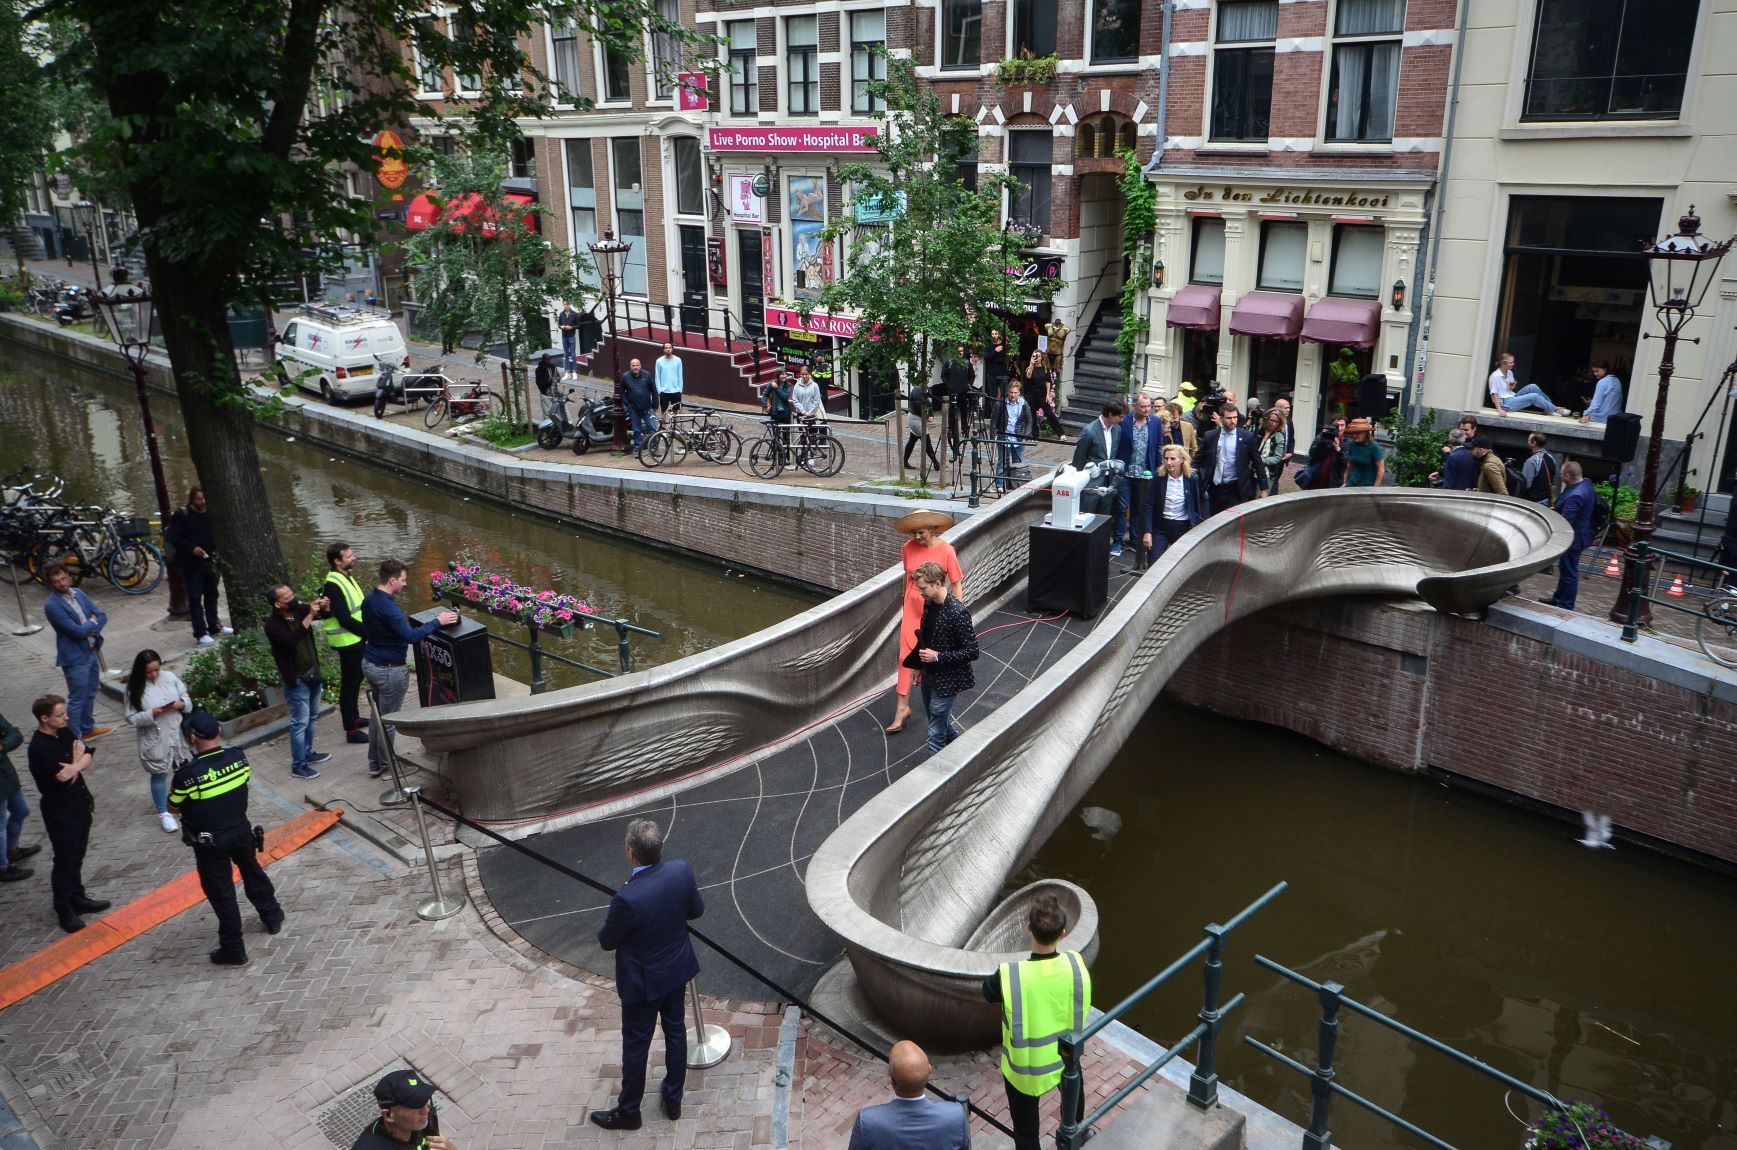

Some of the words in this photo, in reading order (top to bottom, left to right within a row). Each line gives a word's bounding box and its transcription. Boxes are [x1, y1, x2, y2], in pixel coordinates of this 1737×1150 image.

[713, 133, 733, 146] Live
[735, 133, 766, 146] Porno
[768, 133, 797, 147] Show
[803, 133, 849, 149] Hospital
[852, 133, 866, 147] Ba
[1184, 185, 1213, 200] In
[1221, 186, 1252, 201] den
[829, 319, 858, 335] ROSS
[1056, 489, 1070, 497] ABB
